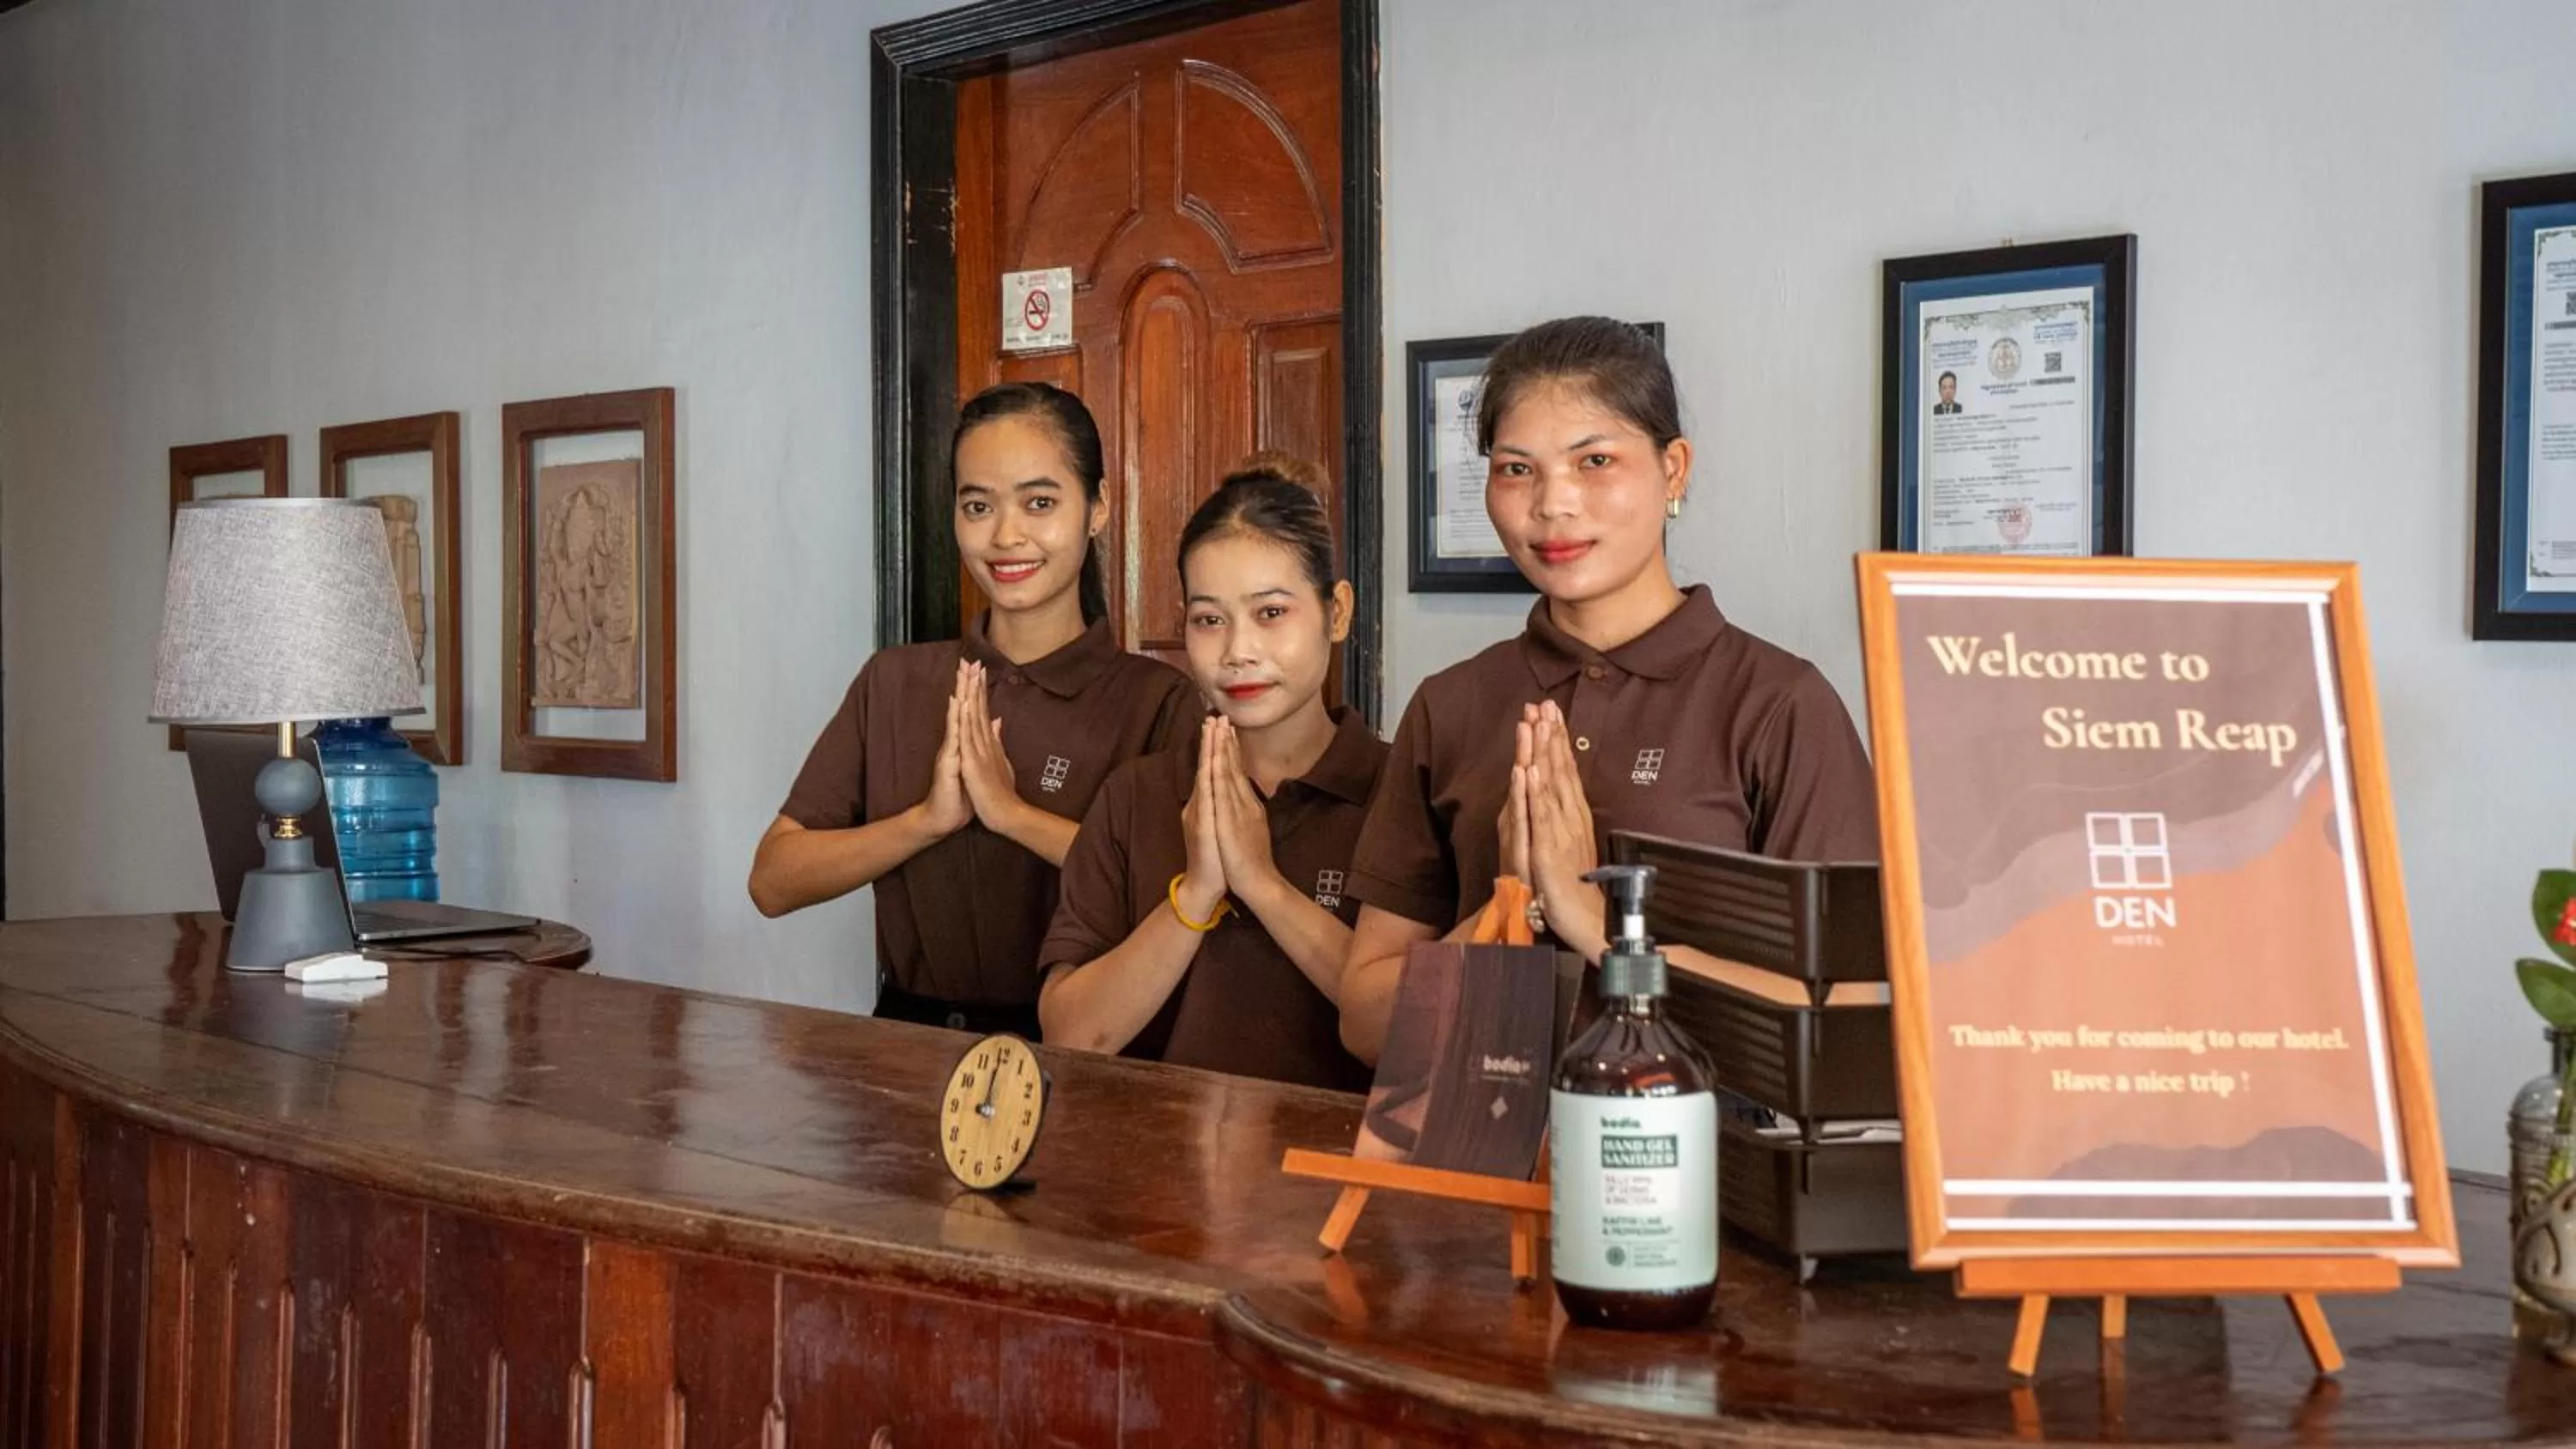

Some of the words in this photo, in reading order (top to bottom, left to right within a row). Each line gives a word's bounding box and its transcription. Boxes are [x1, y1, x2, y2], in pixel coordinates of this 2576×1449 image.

[1925, 631, 2148, 680] Welcome
[2160, 651, 2211, 682] to
[2042, 706, 2162, 749] Siem
[2176, 708, 2298, 767] Reap
[2093, 895, 2178, 930] DEN
[1947, 1023, 2026, 1048] Thank
[2027, 1029, 2074, 1055] you
[2076, 1024, 2113, 1048] for
[2116, 1026, 2206, 1055] coming
[2208, 1030, 2235, 1048] to
[2237, 1031, 2280, 1049] our
[2281, 1027, 2350, 1050] hotel.
[961, 1072, 975, 1088] 10
[2050, 1070, 2112, 1093] Have
[2116, 1073, 2131, 1093] a
[2134, 1070, 2185, 1093] nice
[2189, 1069, 2236, 1099] trip
[1603, 1138, 1645, 1151] HAND
[1646, 1137, 1674, 1151] GEL
[1603, 1152, 1675, 1166] SANITIZER
